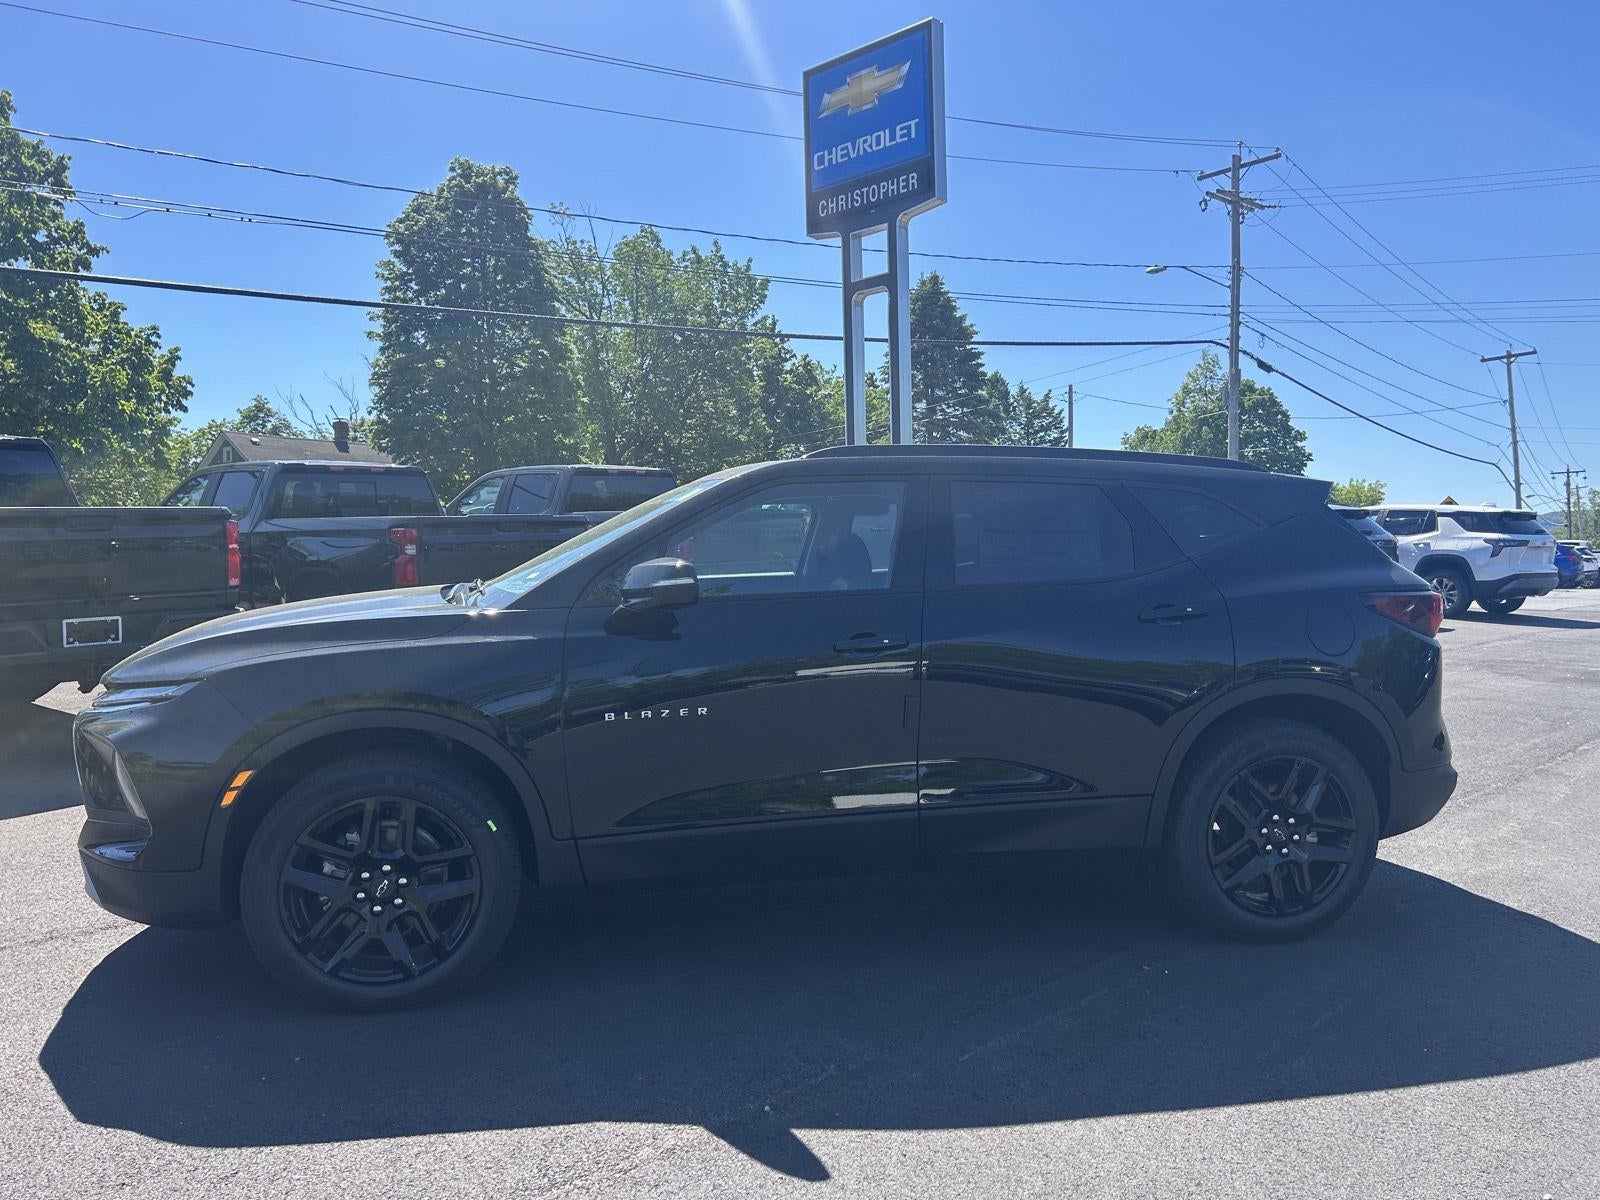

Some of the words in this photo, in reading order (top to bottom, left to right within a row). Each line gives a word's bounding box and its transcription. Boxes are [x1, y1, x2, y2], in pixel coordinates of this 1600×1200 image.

[813, 118, 919, 171] CHEVROLET
[818, 172, 919, 217] CHRISTOPHER
[604, 707, 708, 721] BLAZER
